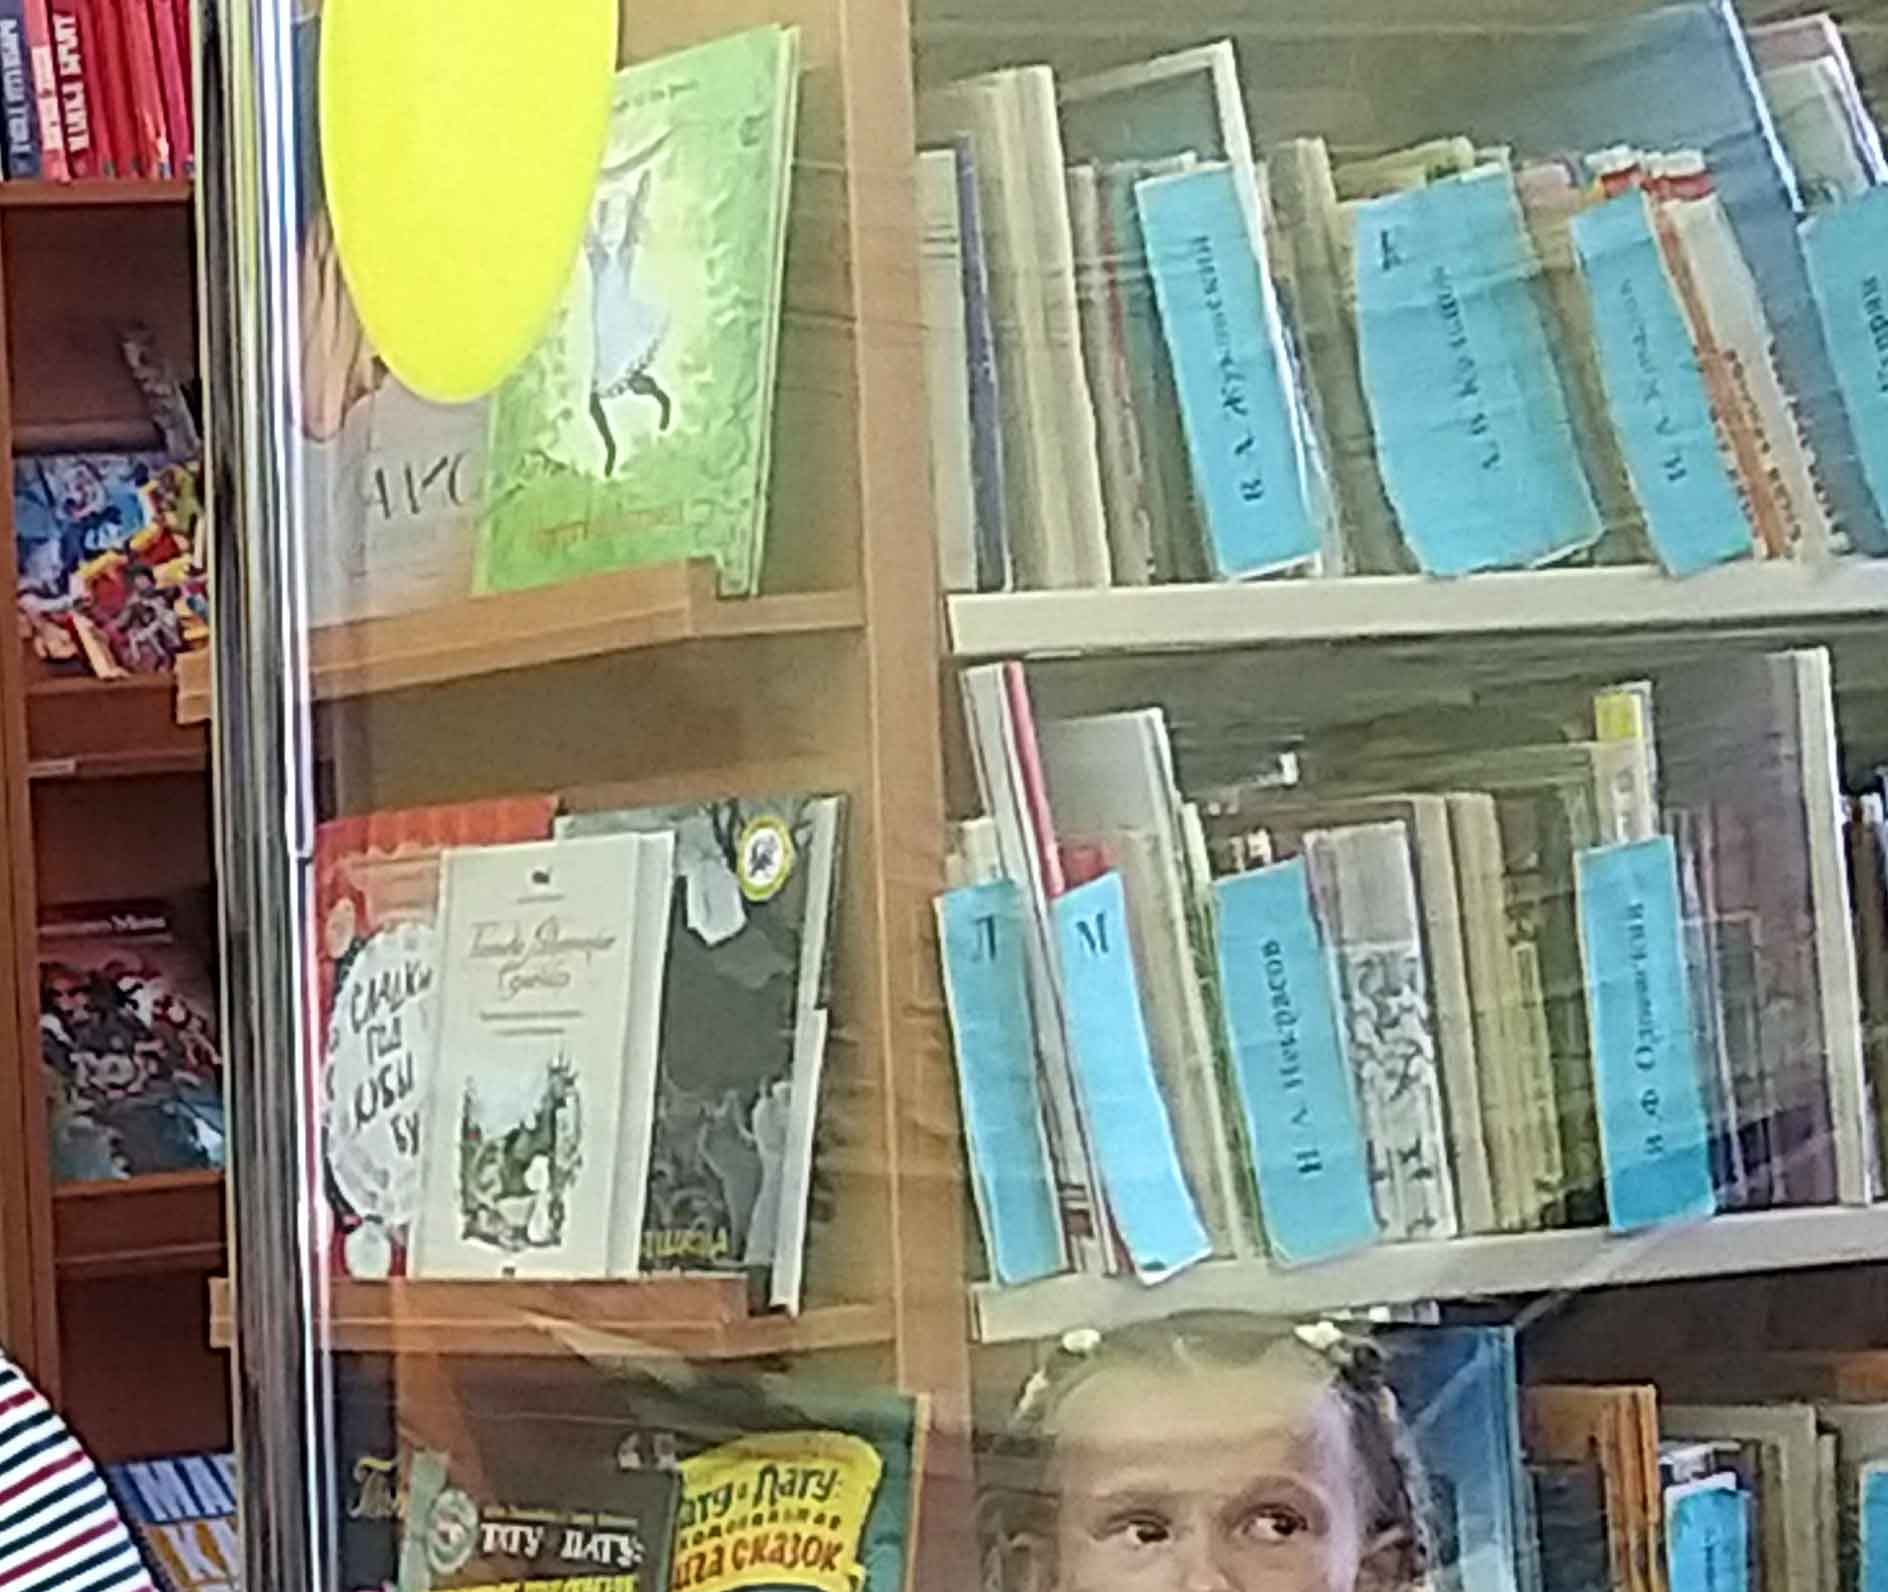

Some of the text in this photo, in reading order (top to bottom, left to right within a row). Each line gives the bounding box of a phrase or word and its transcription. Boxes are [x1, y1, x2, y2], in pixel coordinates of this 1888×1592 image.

[1075, 912, 1113, 957] М
[1261, 938, 1303, 1087] Некрасов
[731, 1532, 845, 1573] сказок
